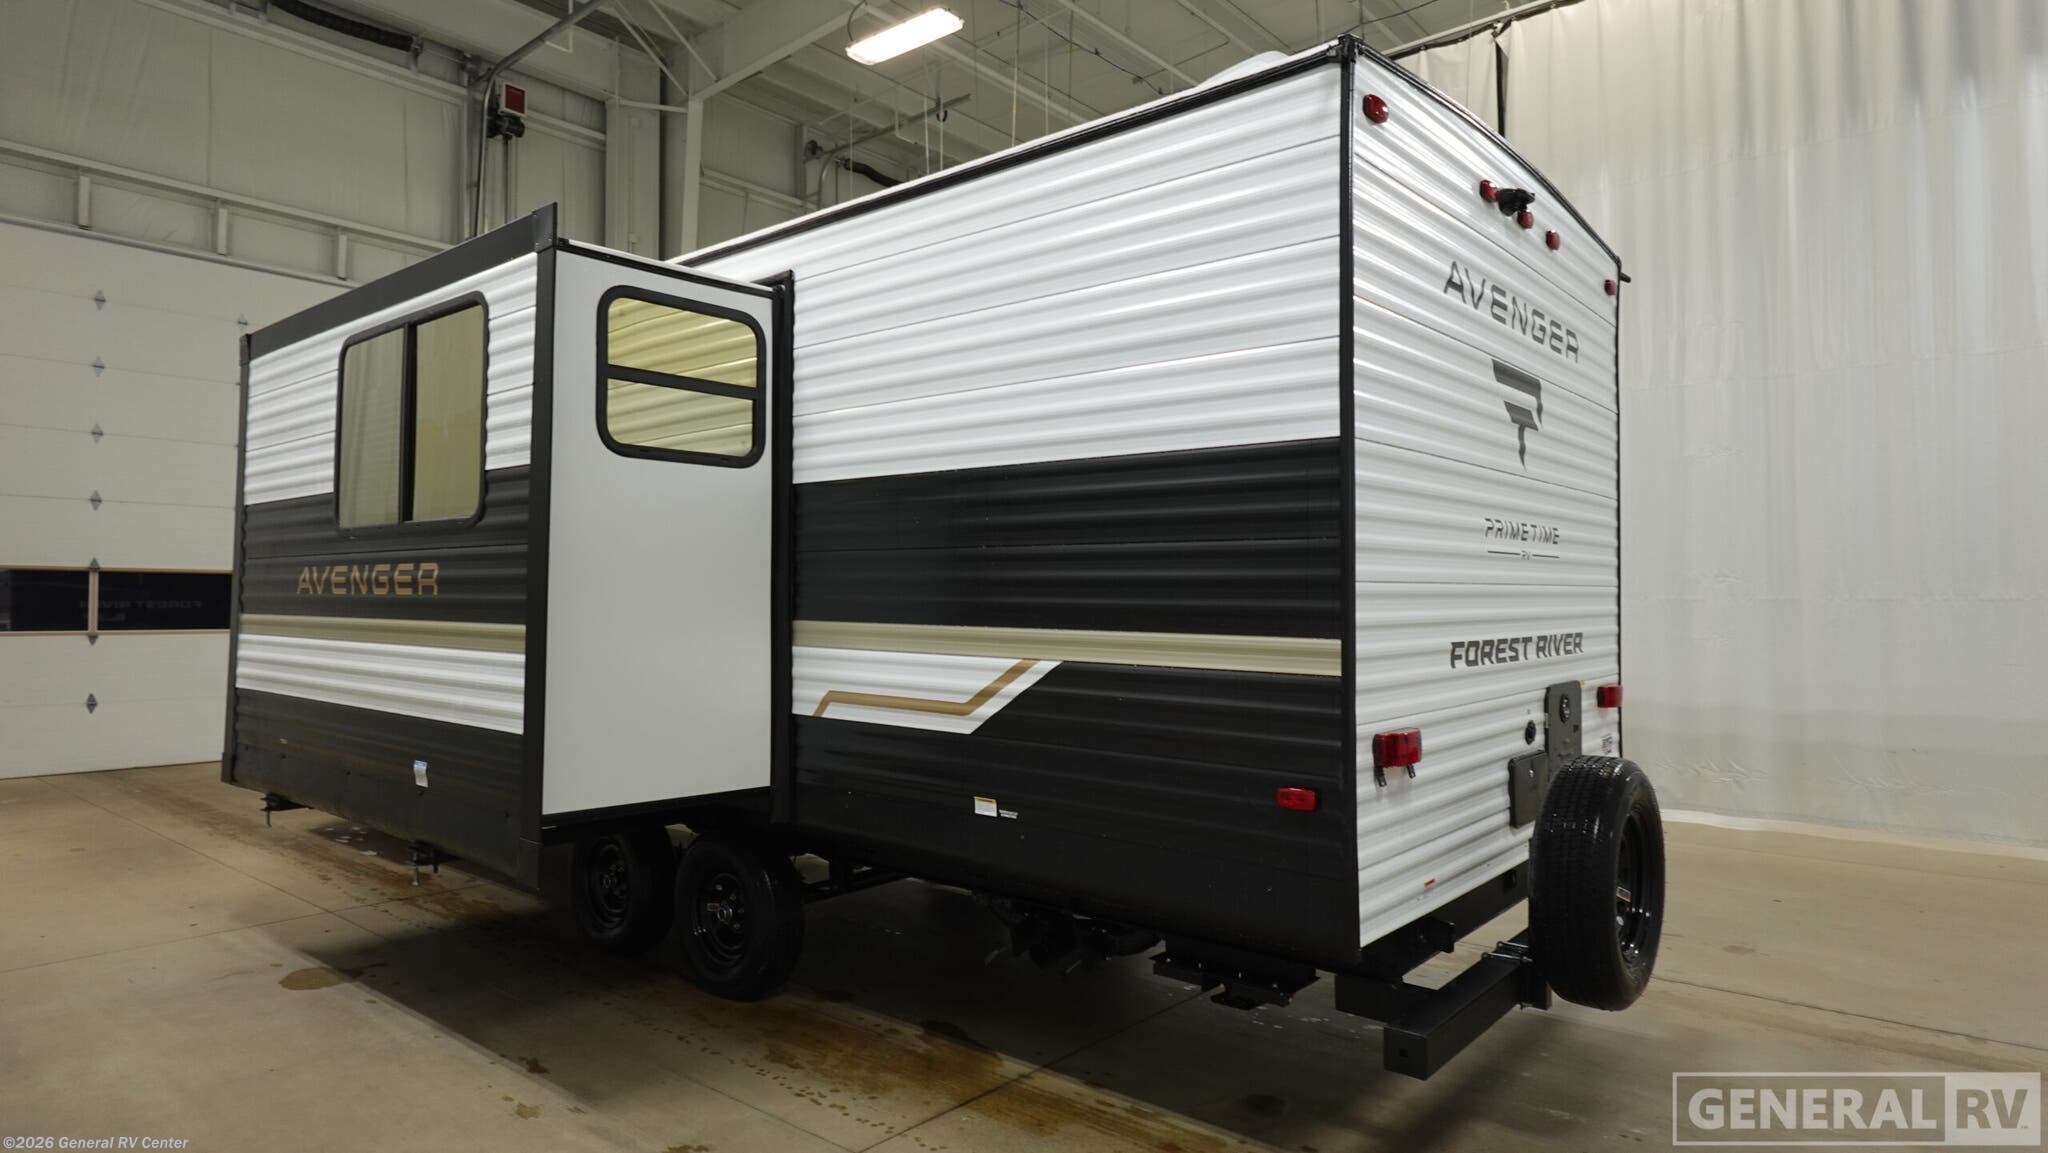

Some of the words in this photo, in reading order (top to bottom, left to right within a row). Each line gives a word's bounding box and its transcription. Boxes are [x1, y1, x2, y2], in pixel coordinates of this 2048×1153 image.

[1443, 260, 1580, 364] AVENGER
[296, 562, 440, 596] AVENGER
[1450, 635, 1533, 669] FOREST
[1535, 631, 1584, 659] RIVER
